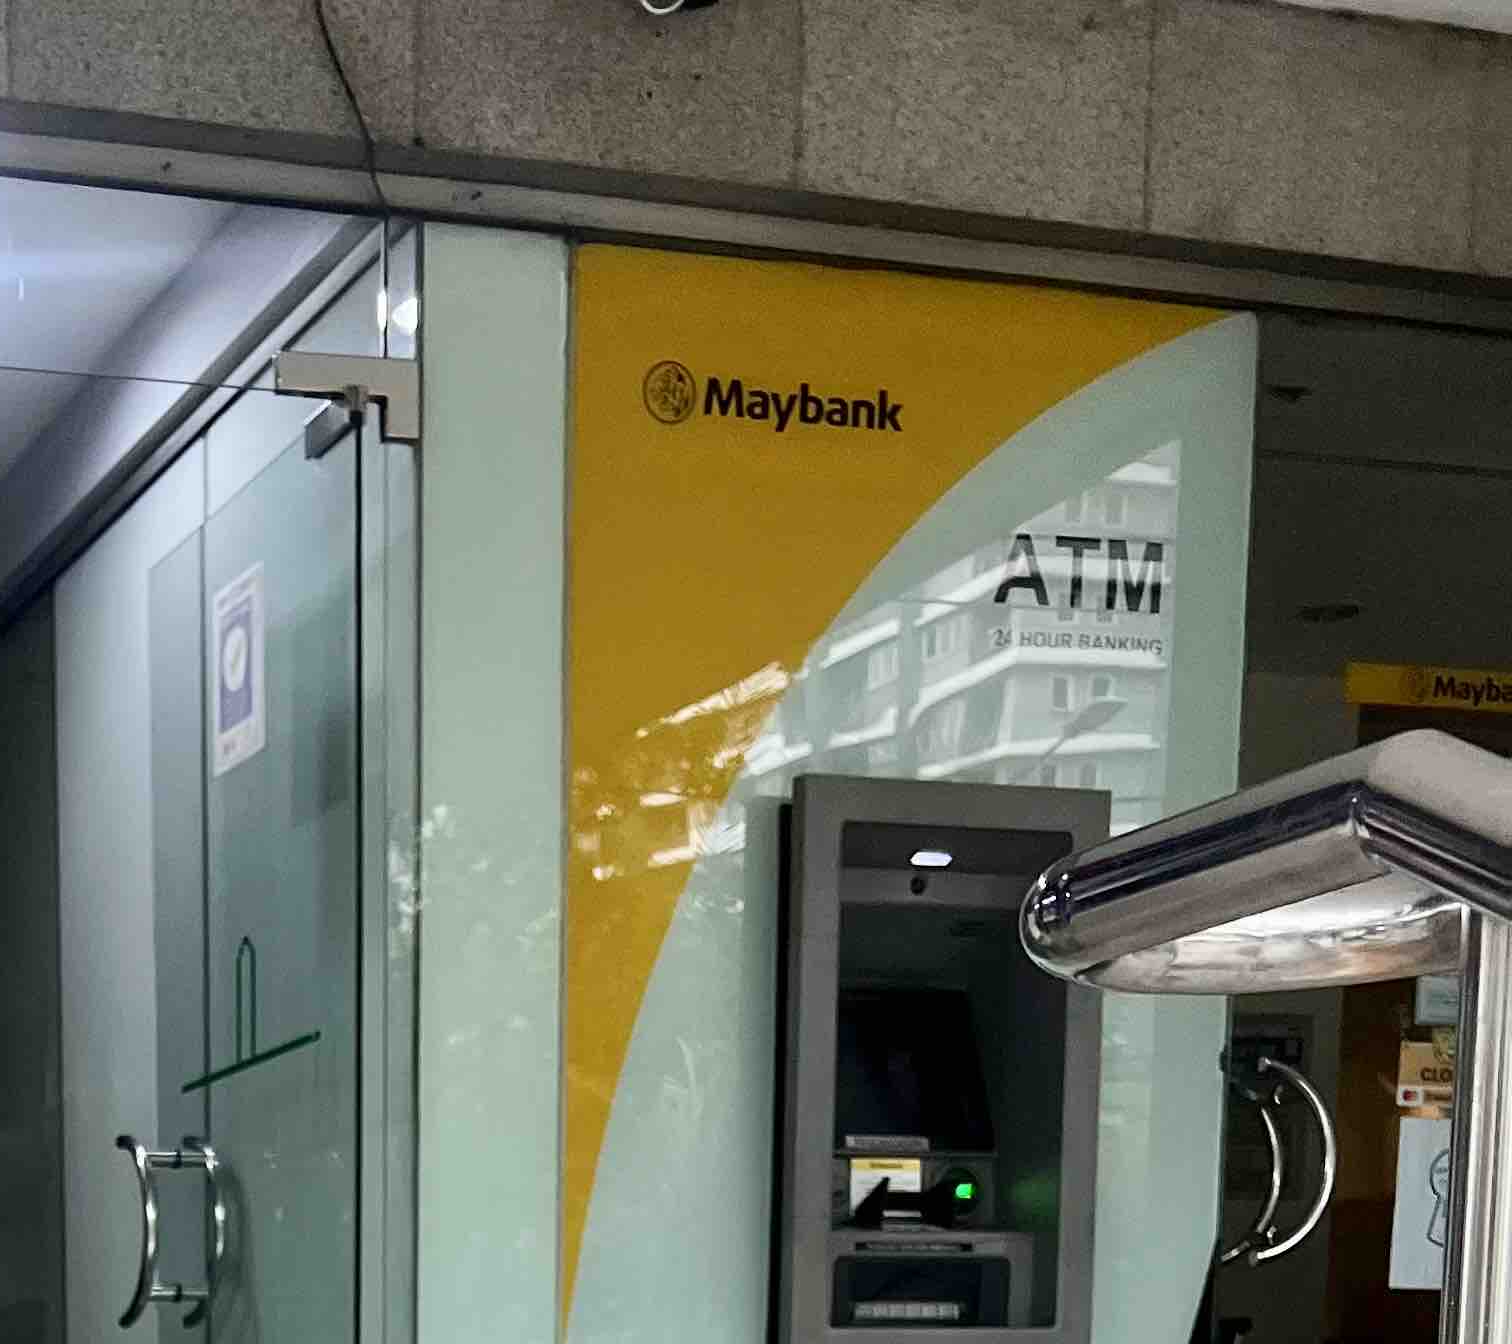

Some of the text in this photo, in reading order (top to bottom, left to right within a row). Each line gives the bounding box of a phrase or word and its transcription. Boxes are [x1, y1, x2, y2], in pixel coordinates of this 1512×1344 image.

[703, 376, 904, 433] Maybank
[993, 533, 1164, 615] ATM
[992, 628, 1163, 656] 24 HOUR BANKING
[1432, 674, 1512, 707] Mayba
